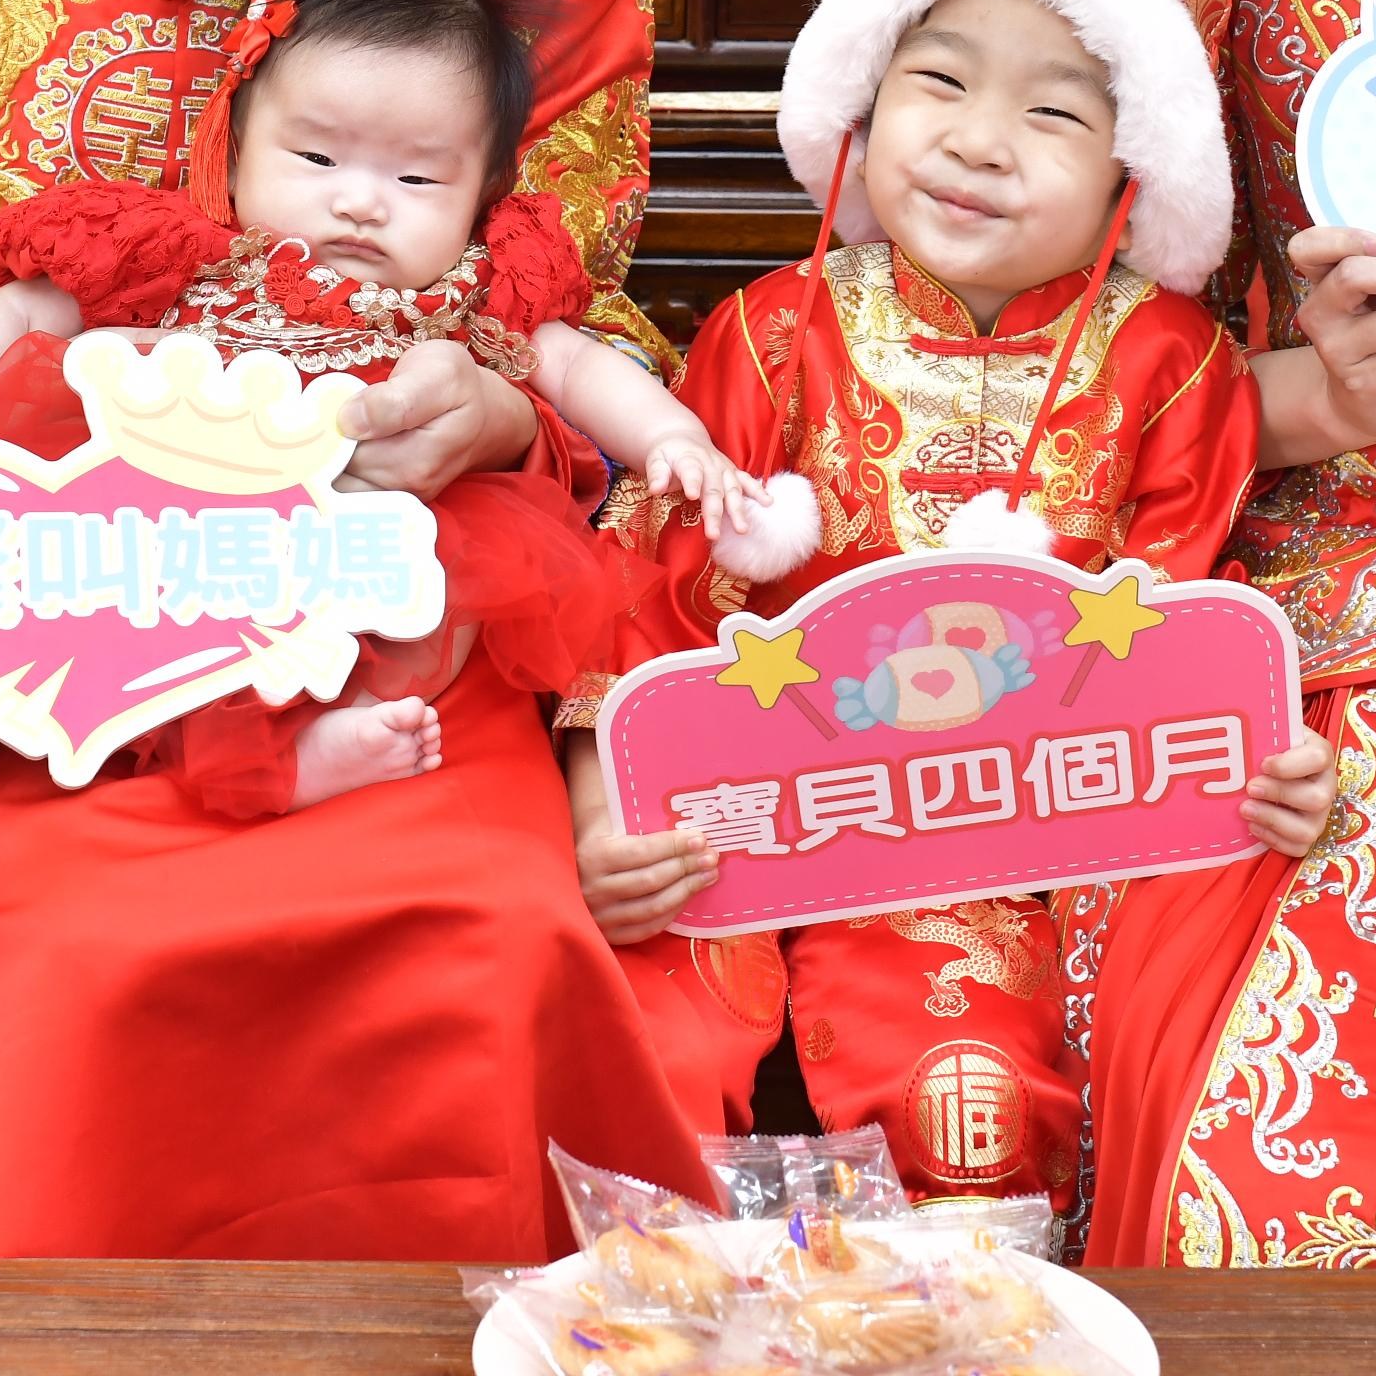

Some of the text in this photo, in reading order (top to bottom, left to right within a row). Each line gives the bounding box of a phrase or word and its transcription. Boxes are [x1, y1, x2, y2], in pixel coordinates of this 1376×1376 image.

[668, 713, 1248, 857] 寶貝四個月
[915, 1053, 1024, 1170] 福
